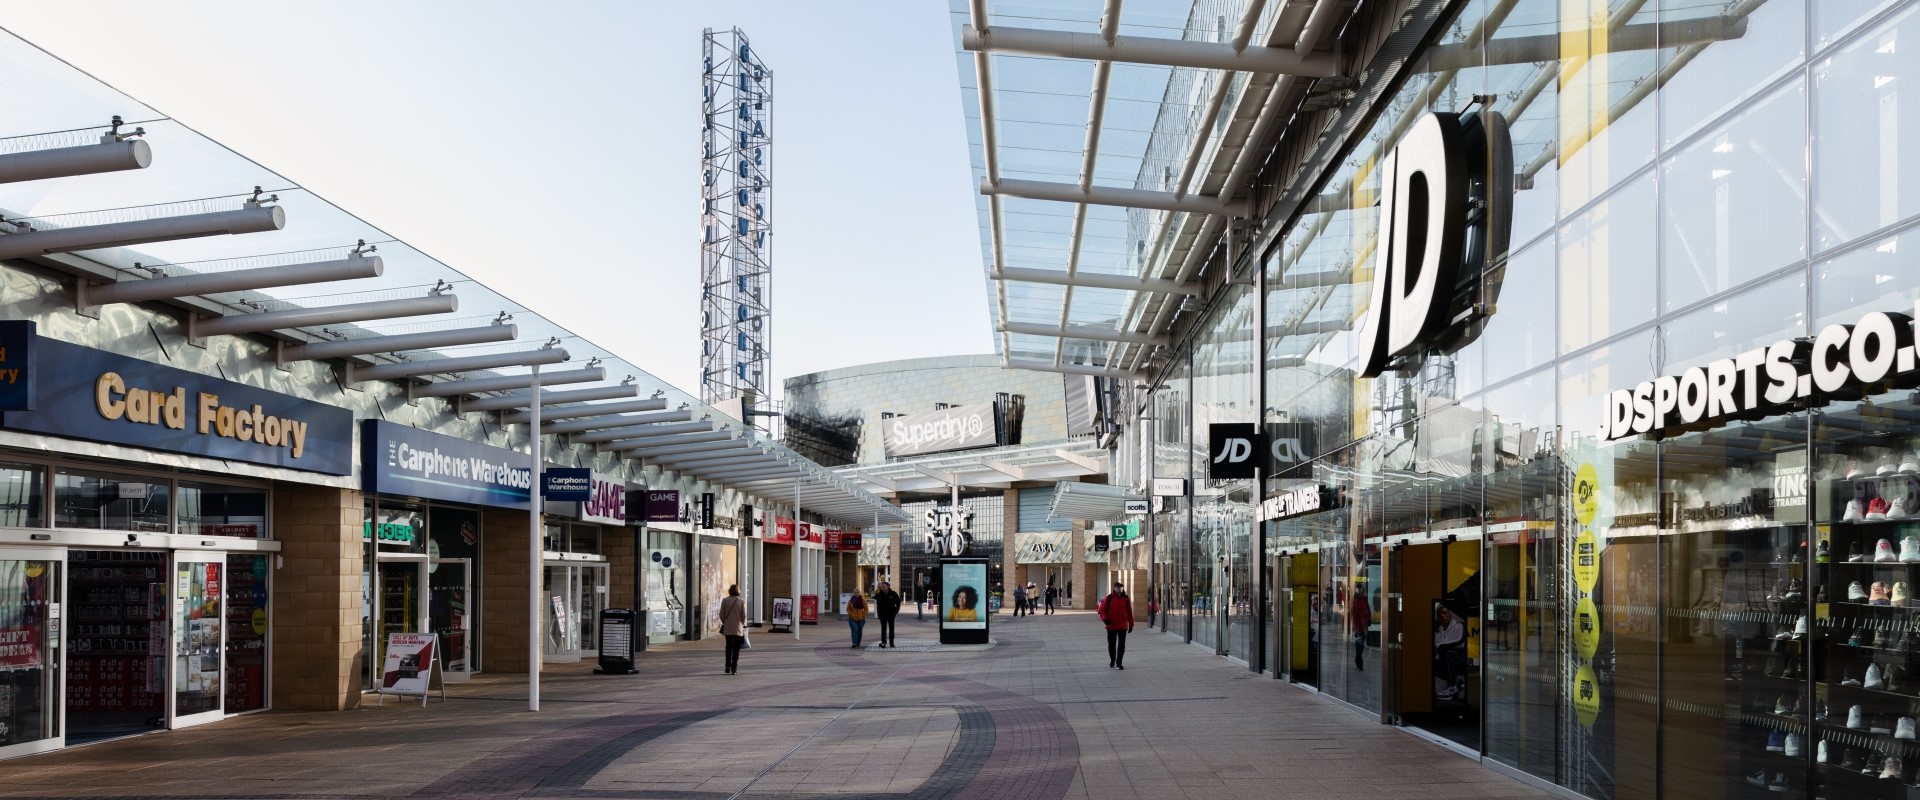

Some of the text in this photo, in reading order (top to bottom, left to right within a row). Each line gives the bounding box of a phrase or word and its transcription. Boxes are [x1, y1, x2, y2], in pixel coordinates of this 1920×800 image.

[1359, 111, 1448, 379] JD
[95, 371, 308, 459] Card Factory
[388, 439, 397, 467] THE
[1214, 437, 1252, 464] JD
[398, 442, 532, 489] Carphone Warehous
[551, 477, 589, 485] Carphone
[650, 493, 676, 502] GAME
[1127, 503, 1146, 511] scotts
[1285, 484, 1319, 516] TRAINERS
[925, 509, 966, 537] Supr
[1115, 527, 1125, 537] D
[1030, 543, 1055, 553] ZARA
[0, 630, 30, 644] GIFT
